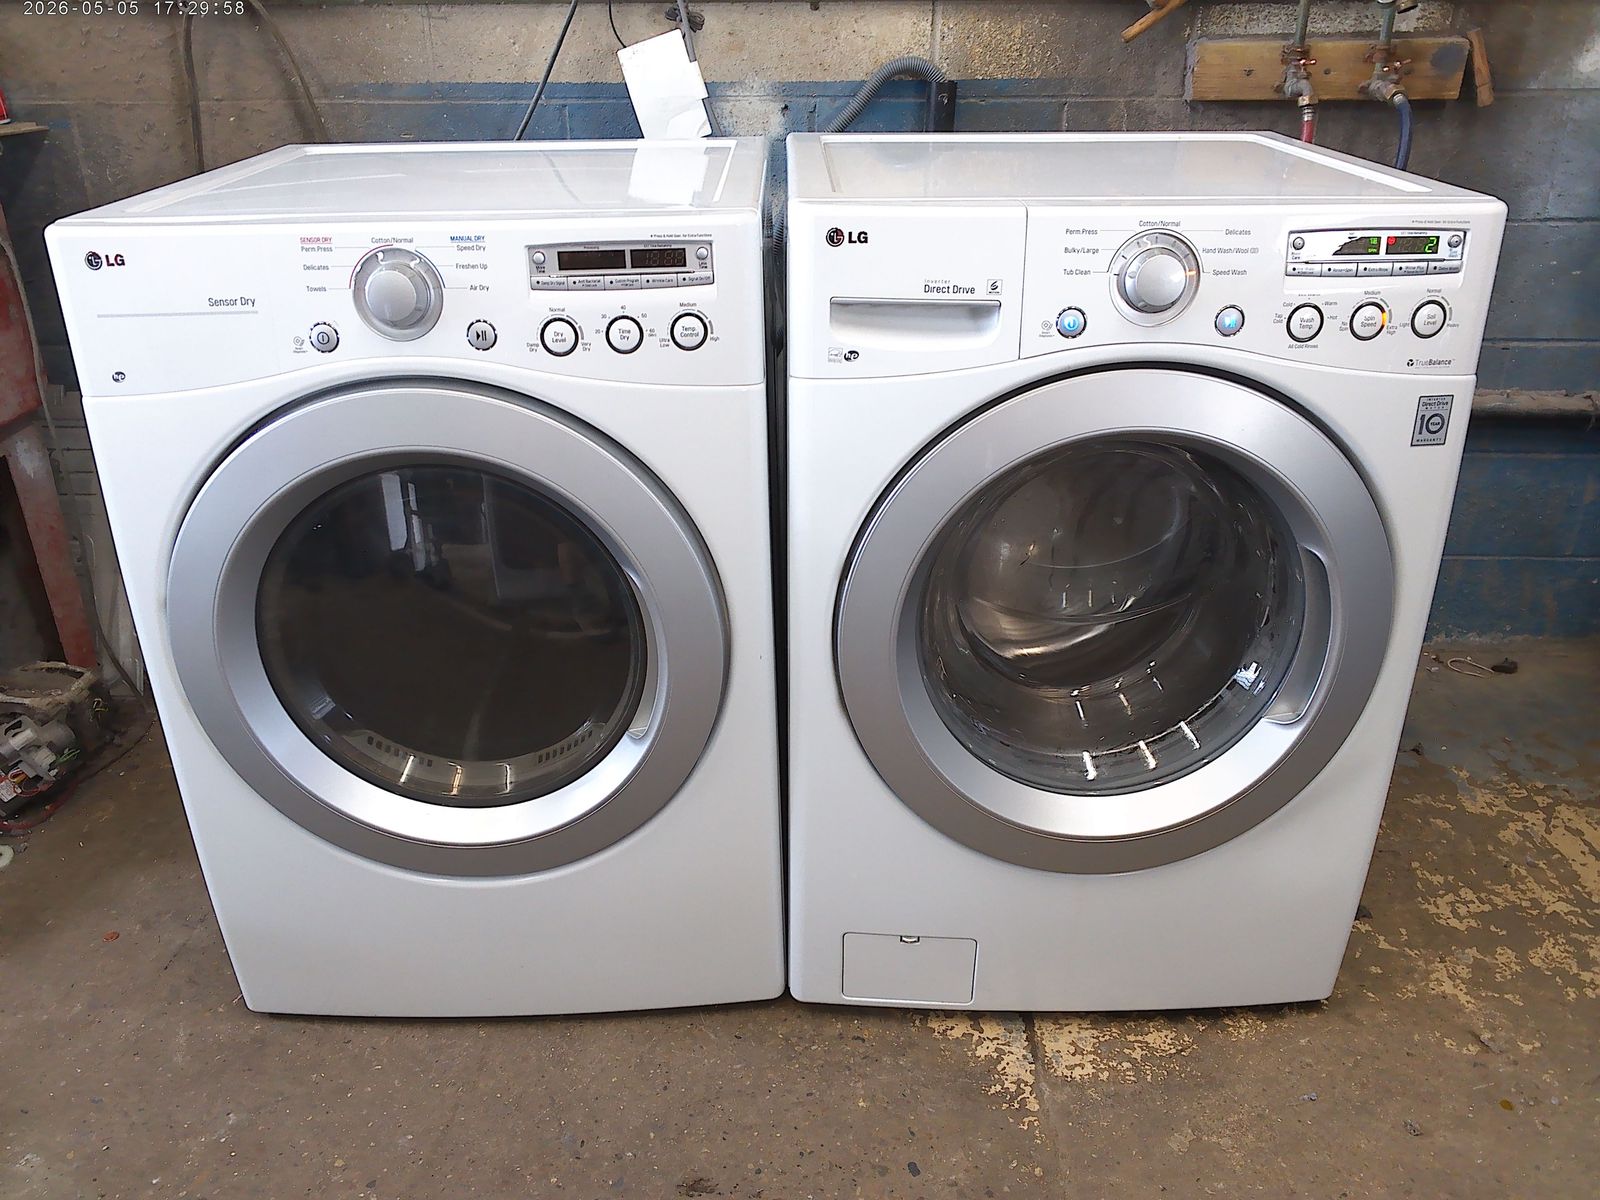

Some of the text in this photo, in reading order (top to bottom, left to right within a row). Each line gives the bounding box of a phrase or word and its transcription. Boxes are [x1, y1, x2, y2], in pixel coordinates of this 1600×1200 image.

[848, 231, 868, 244] LG
[1424, 237, 1437, 252] 2
[105, 254, 126, 266] LG
[924, 284, 975, 294] Direct Drive
[208, 297, 256, 308] Sensor Dry
